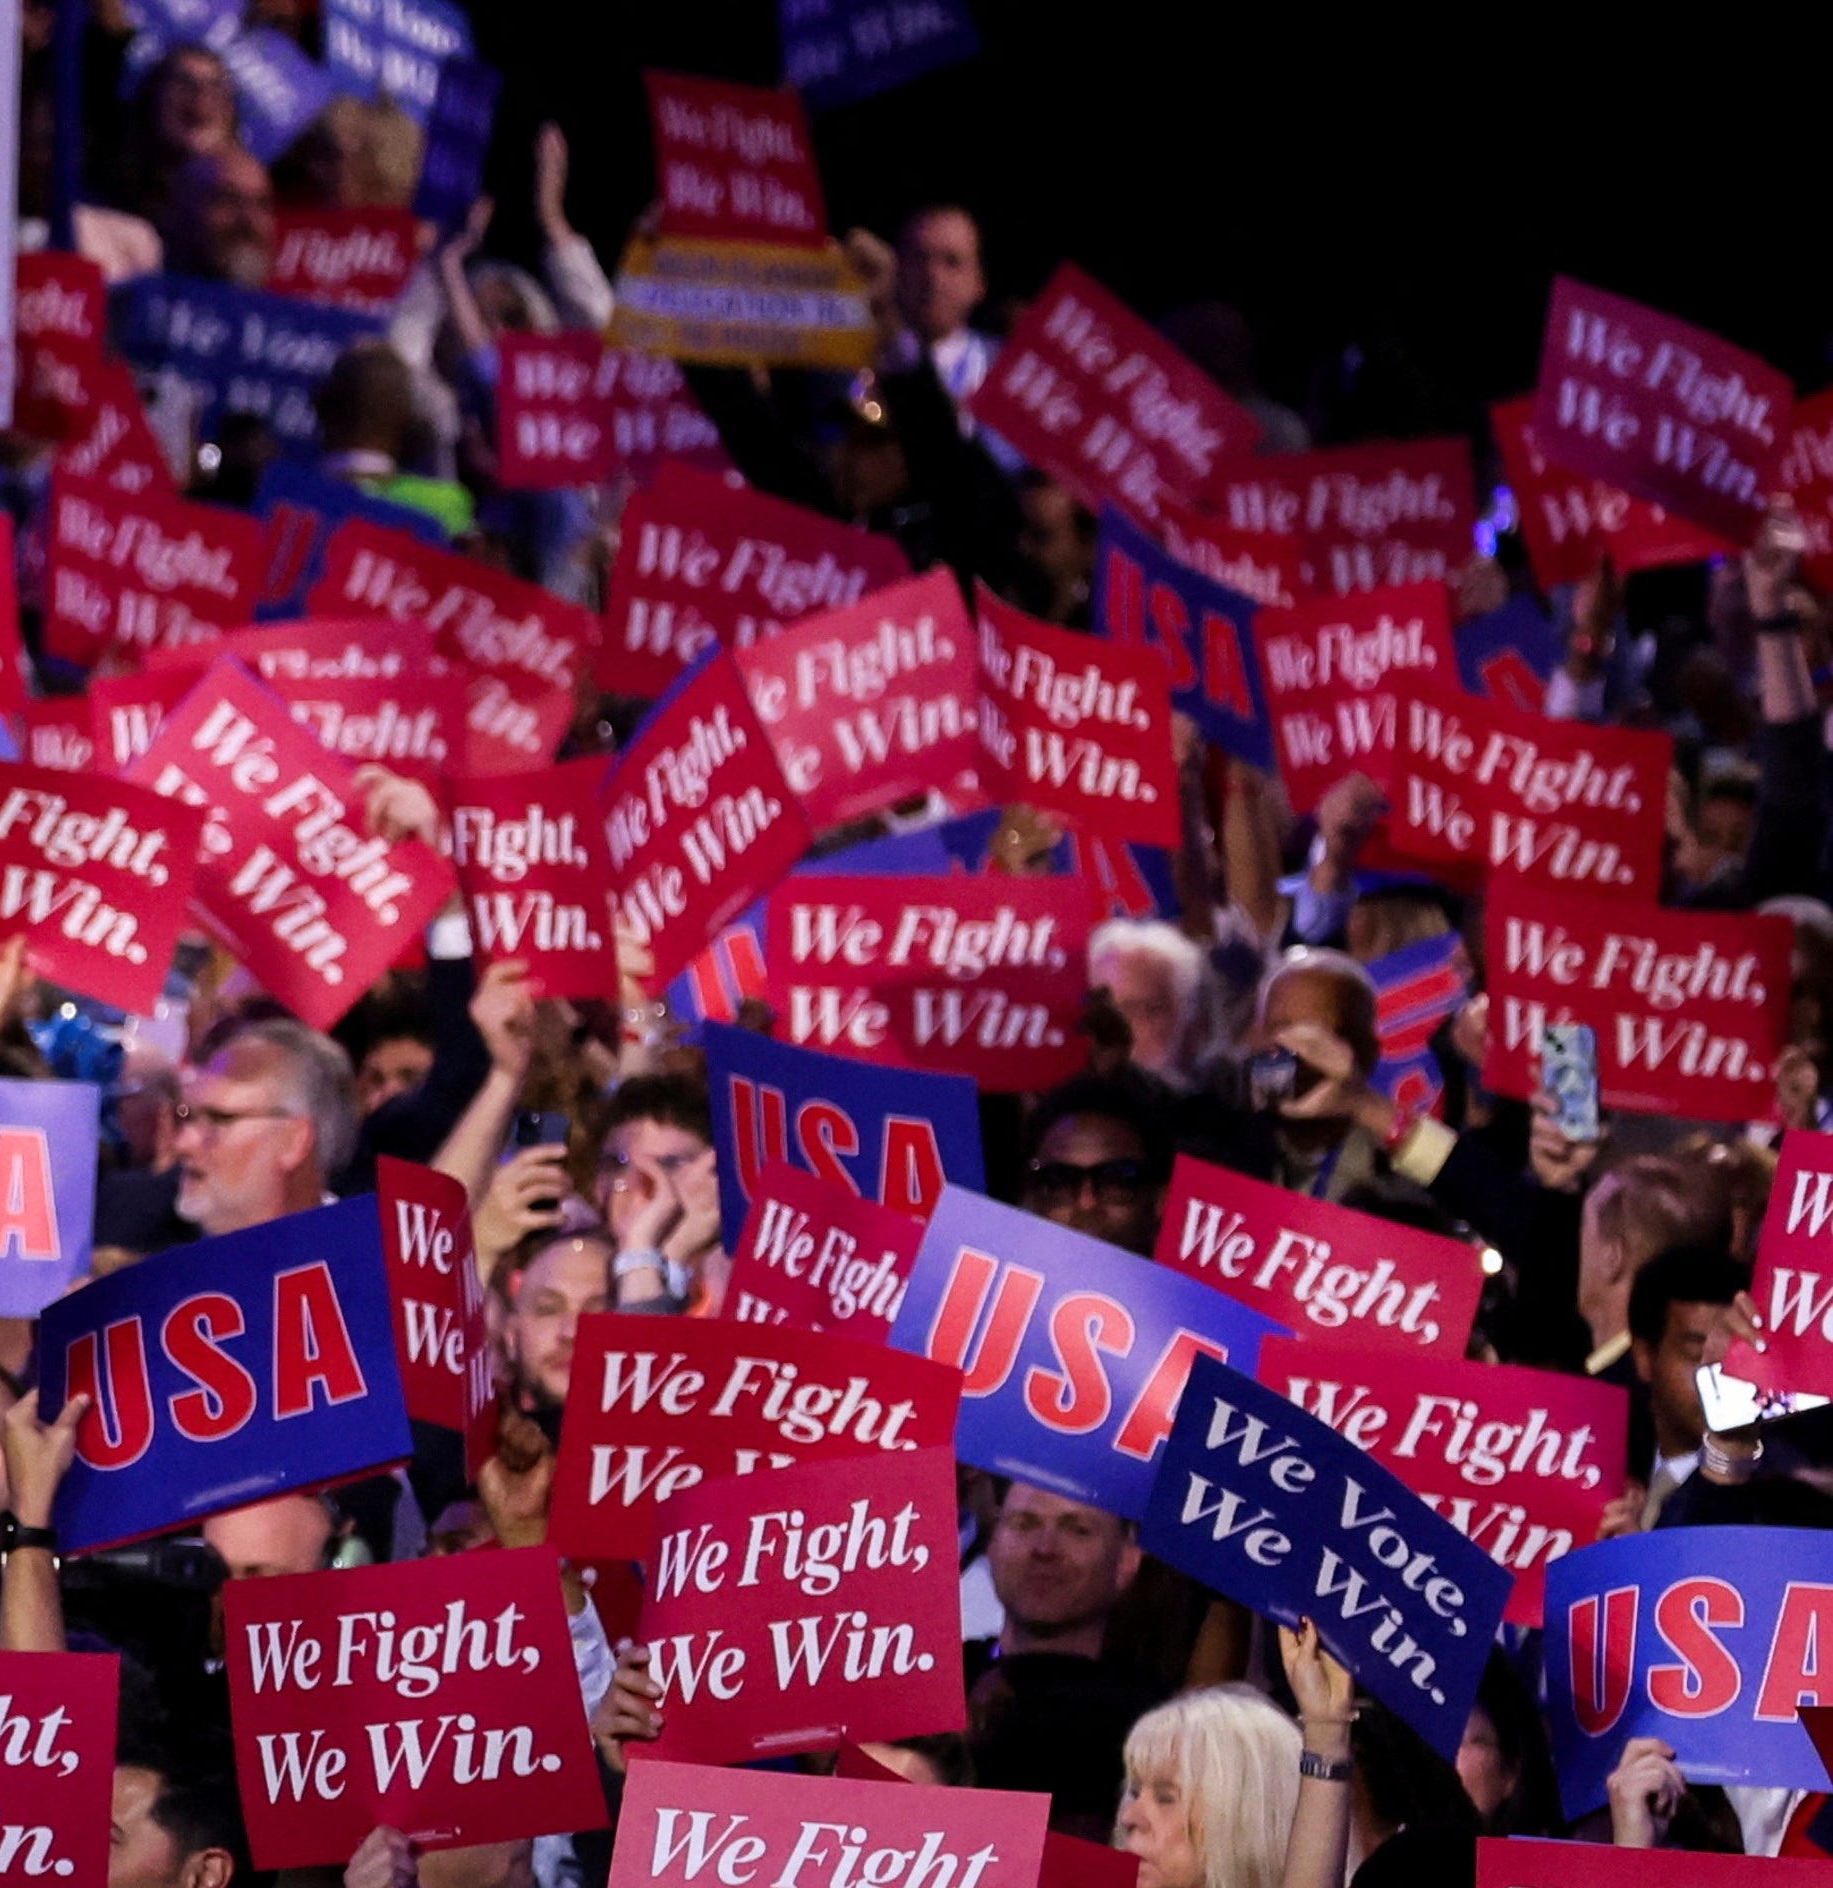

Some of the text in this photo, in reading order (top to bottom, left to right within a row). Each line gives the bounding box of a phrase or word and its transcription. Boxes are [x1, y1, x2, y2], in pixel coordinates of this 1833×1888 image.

[1, 867, 147, 964] Win.
[1180, 1199, 1439, 1343] We Fight,
[65, 1262, 367, 1469] USA
[657, 1499, 928, 1601] We Fight,
[1206, 1398, 1476, 1646] We Vote,
[1181, 1472, 1461, 1704] We Win.
[246, 1600, 539, 1697] We Fight,
[769, 1611, 934, 1690] Win.
[257, 1714, 561, 1804] We Win.
[652, 1809, 766, 1885] We
